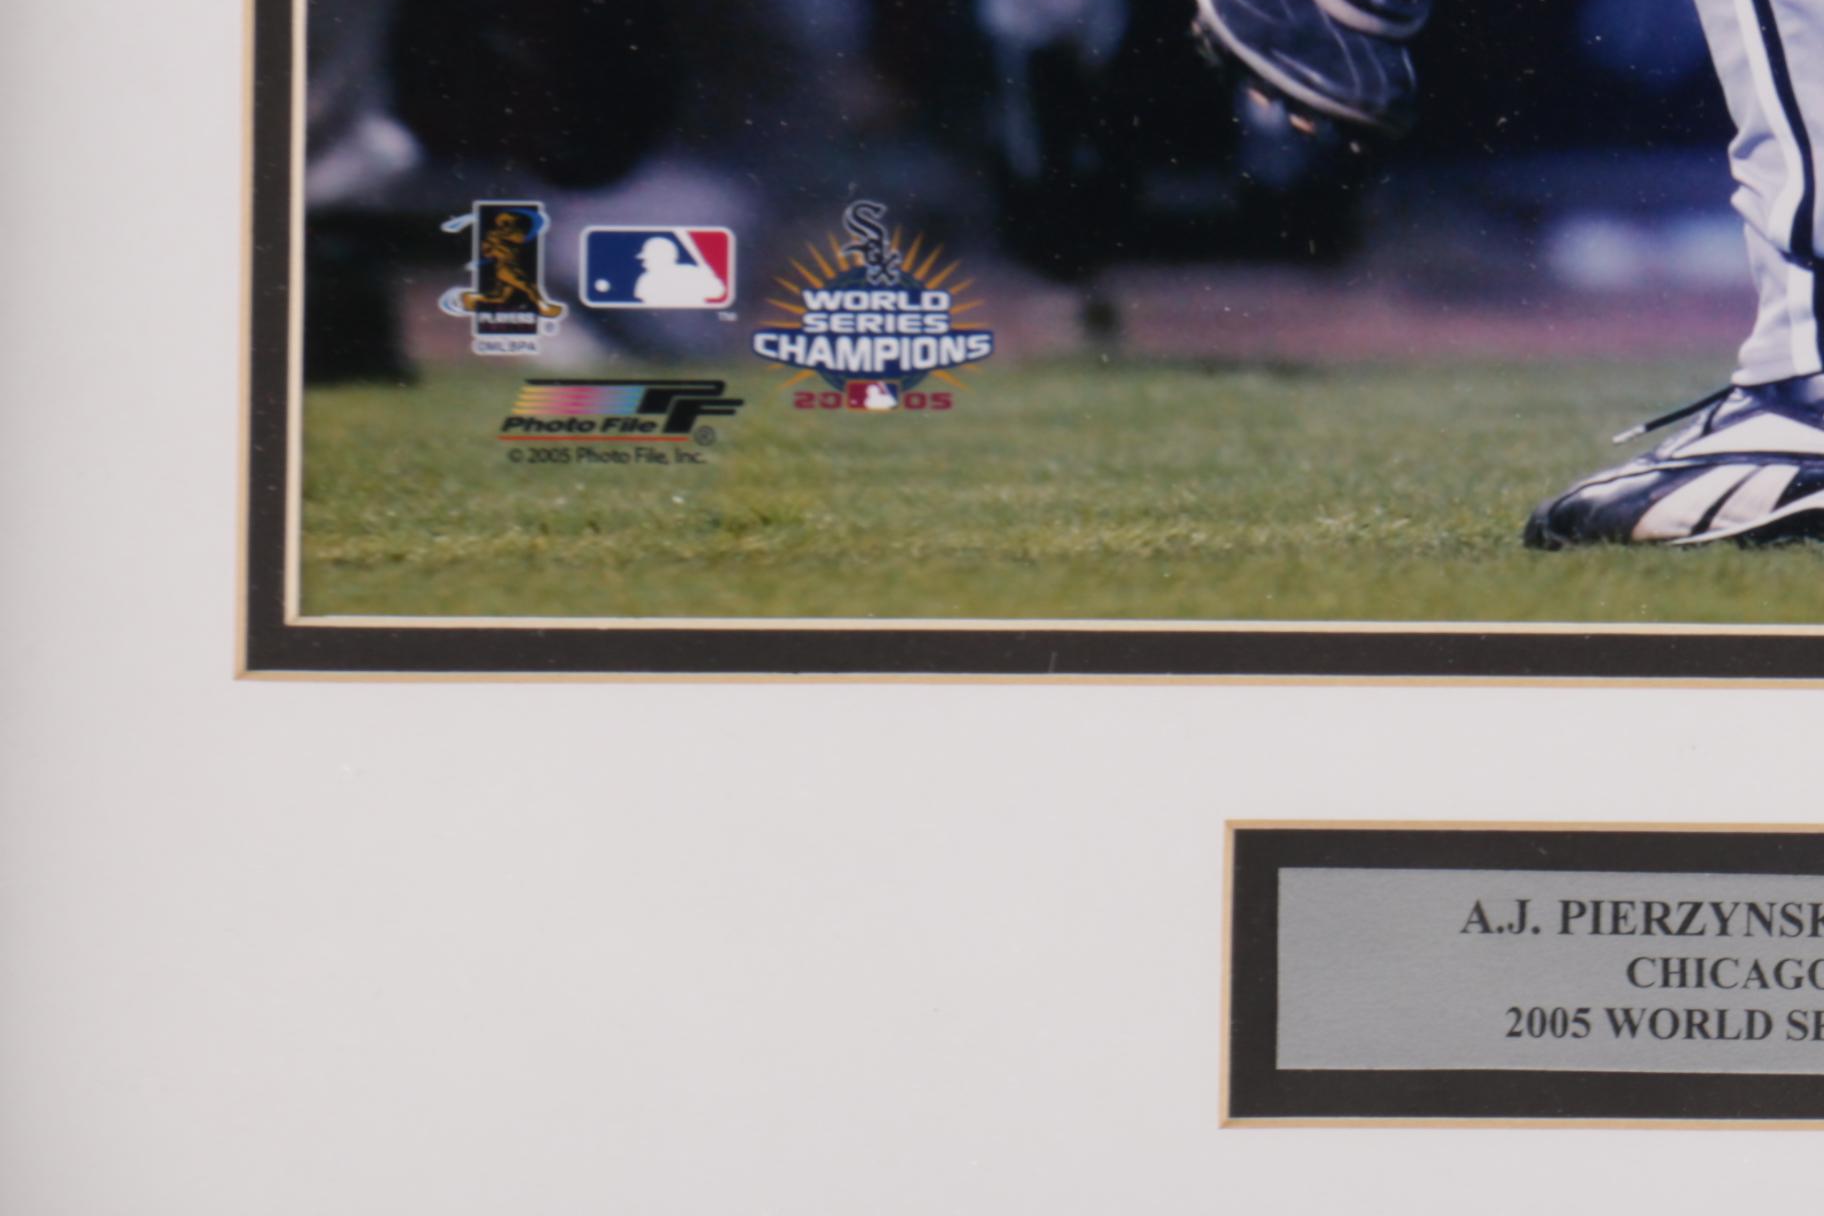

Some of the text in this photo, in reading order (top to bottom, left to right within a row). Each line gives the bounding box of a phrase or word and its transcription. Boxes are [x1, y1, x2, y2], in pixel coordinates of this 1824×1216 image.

[802, 290, 950, 311] WORLD
[803, 313, 949, 333] SERIES
[753, 333, 993, 372] CHAMPIONS
[502, 416, 657, 433] Photo File
[527, 447, 570, 464] 2005
[576, 447, 630, 464] Photo
[675, 449, 706, 465] Inc.
[1460, 898, 1541, 935] A.J.
[1505, 1006, 1592, 1039] 2005
[1603, 1007, 1774, 1041] WORLD
